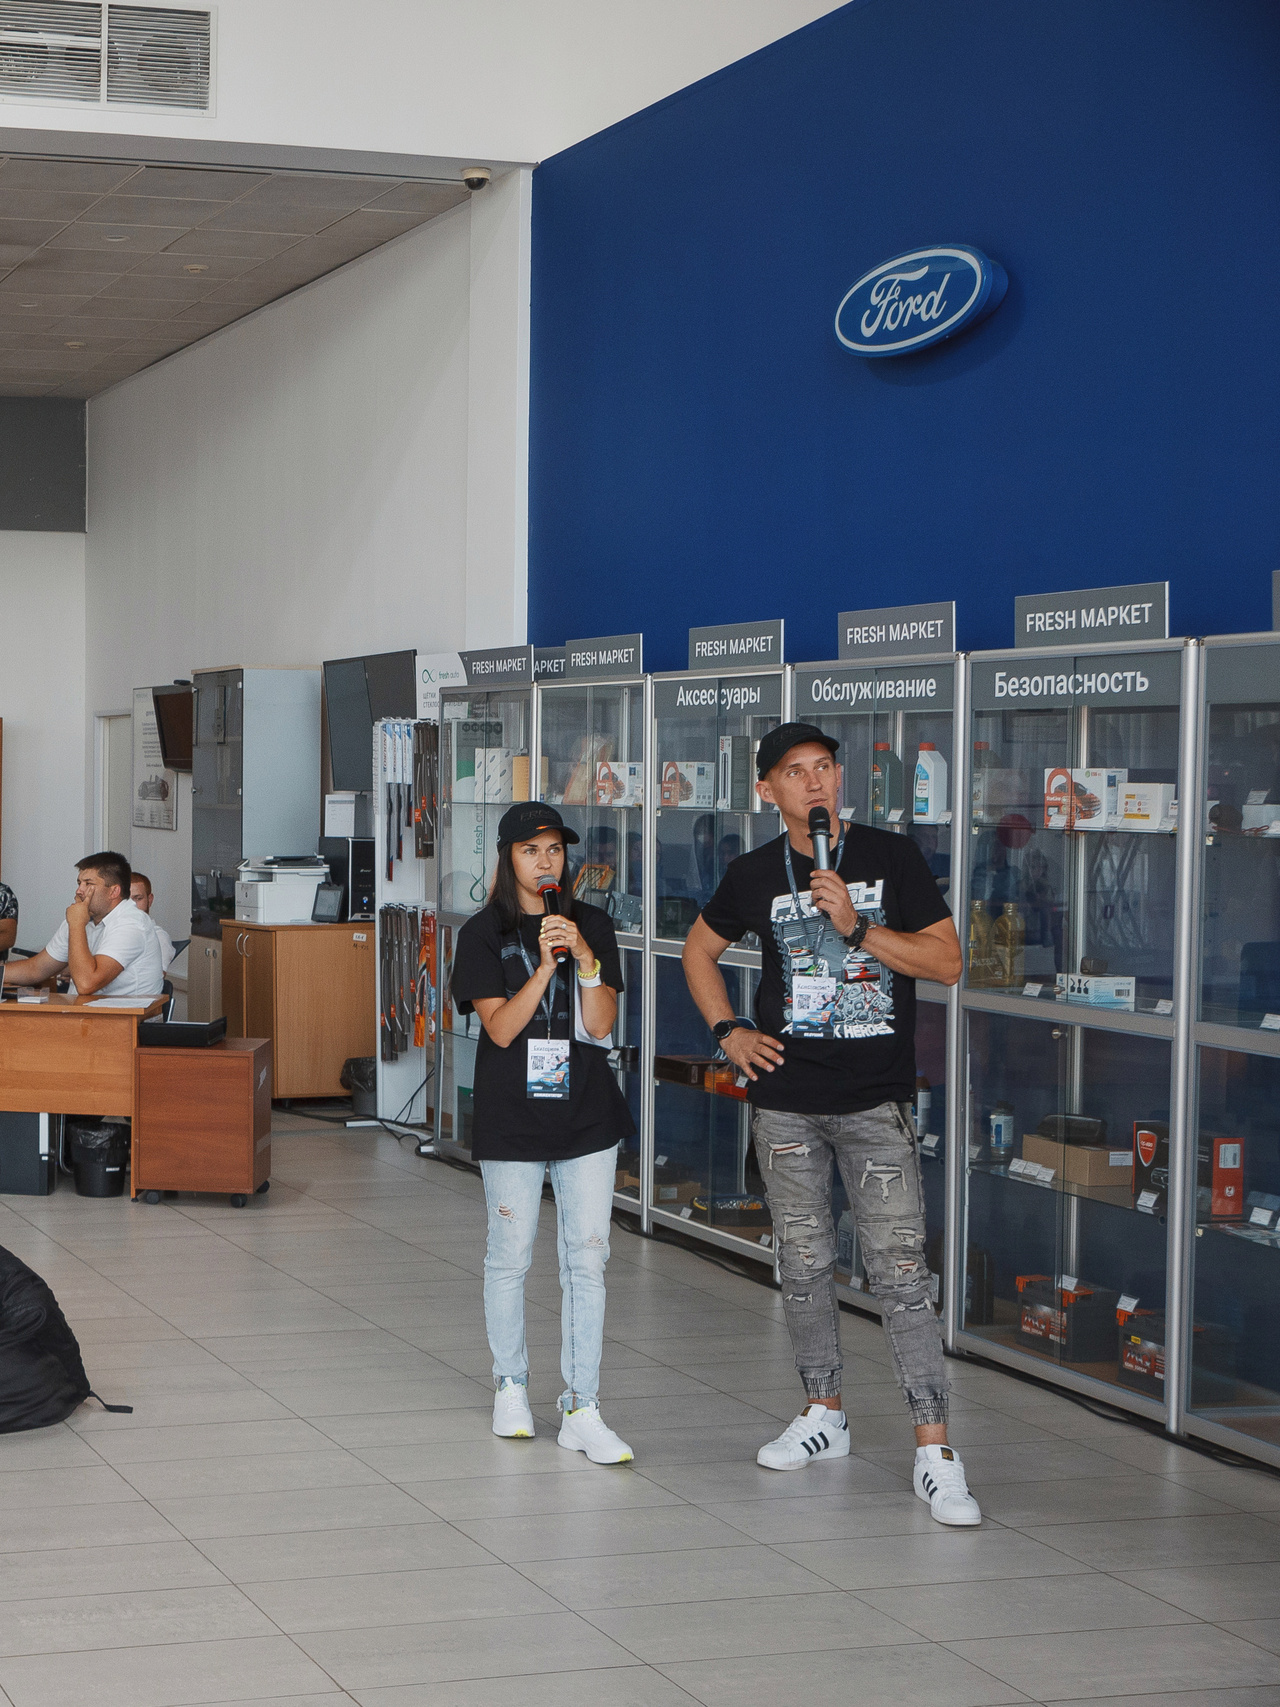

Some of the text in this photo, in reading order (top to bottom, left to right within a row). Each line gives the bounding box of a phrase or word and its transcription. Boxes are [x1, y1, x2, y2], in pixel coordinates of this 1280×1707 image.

[860, 264, 951, 338] Ford
[1026, 603, 1153, 633] FRESH МАРКЕТ
[846, 619, 944, 645] FRESH МАРКЕТ
[571, 647, 635, 667] FRESH МАРКЕТ
[695, 635, 774, 657] FRESH МАРКЕТ
[472, 657, 527, 675] FRESH МАРКЕТ
[534, 658, 566, 673] АРКЕТ
[811, 676, 937, 706] Обслуживание
[994, 670, 1149, 698] Безопасность
[676, 685, 761, 710] Аксессуары
[473, 825, 483, 855] fresh
[843, 1021, 895, 1038] HEROES
